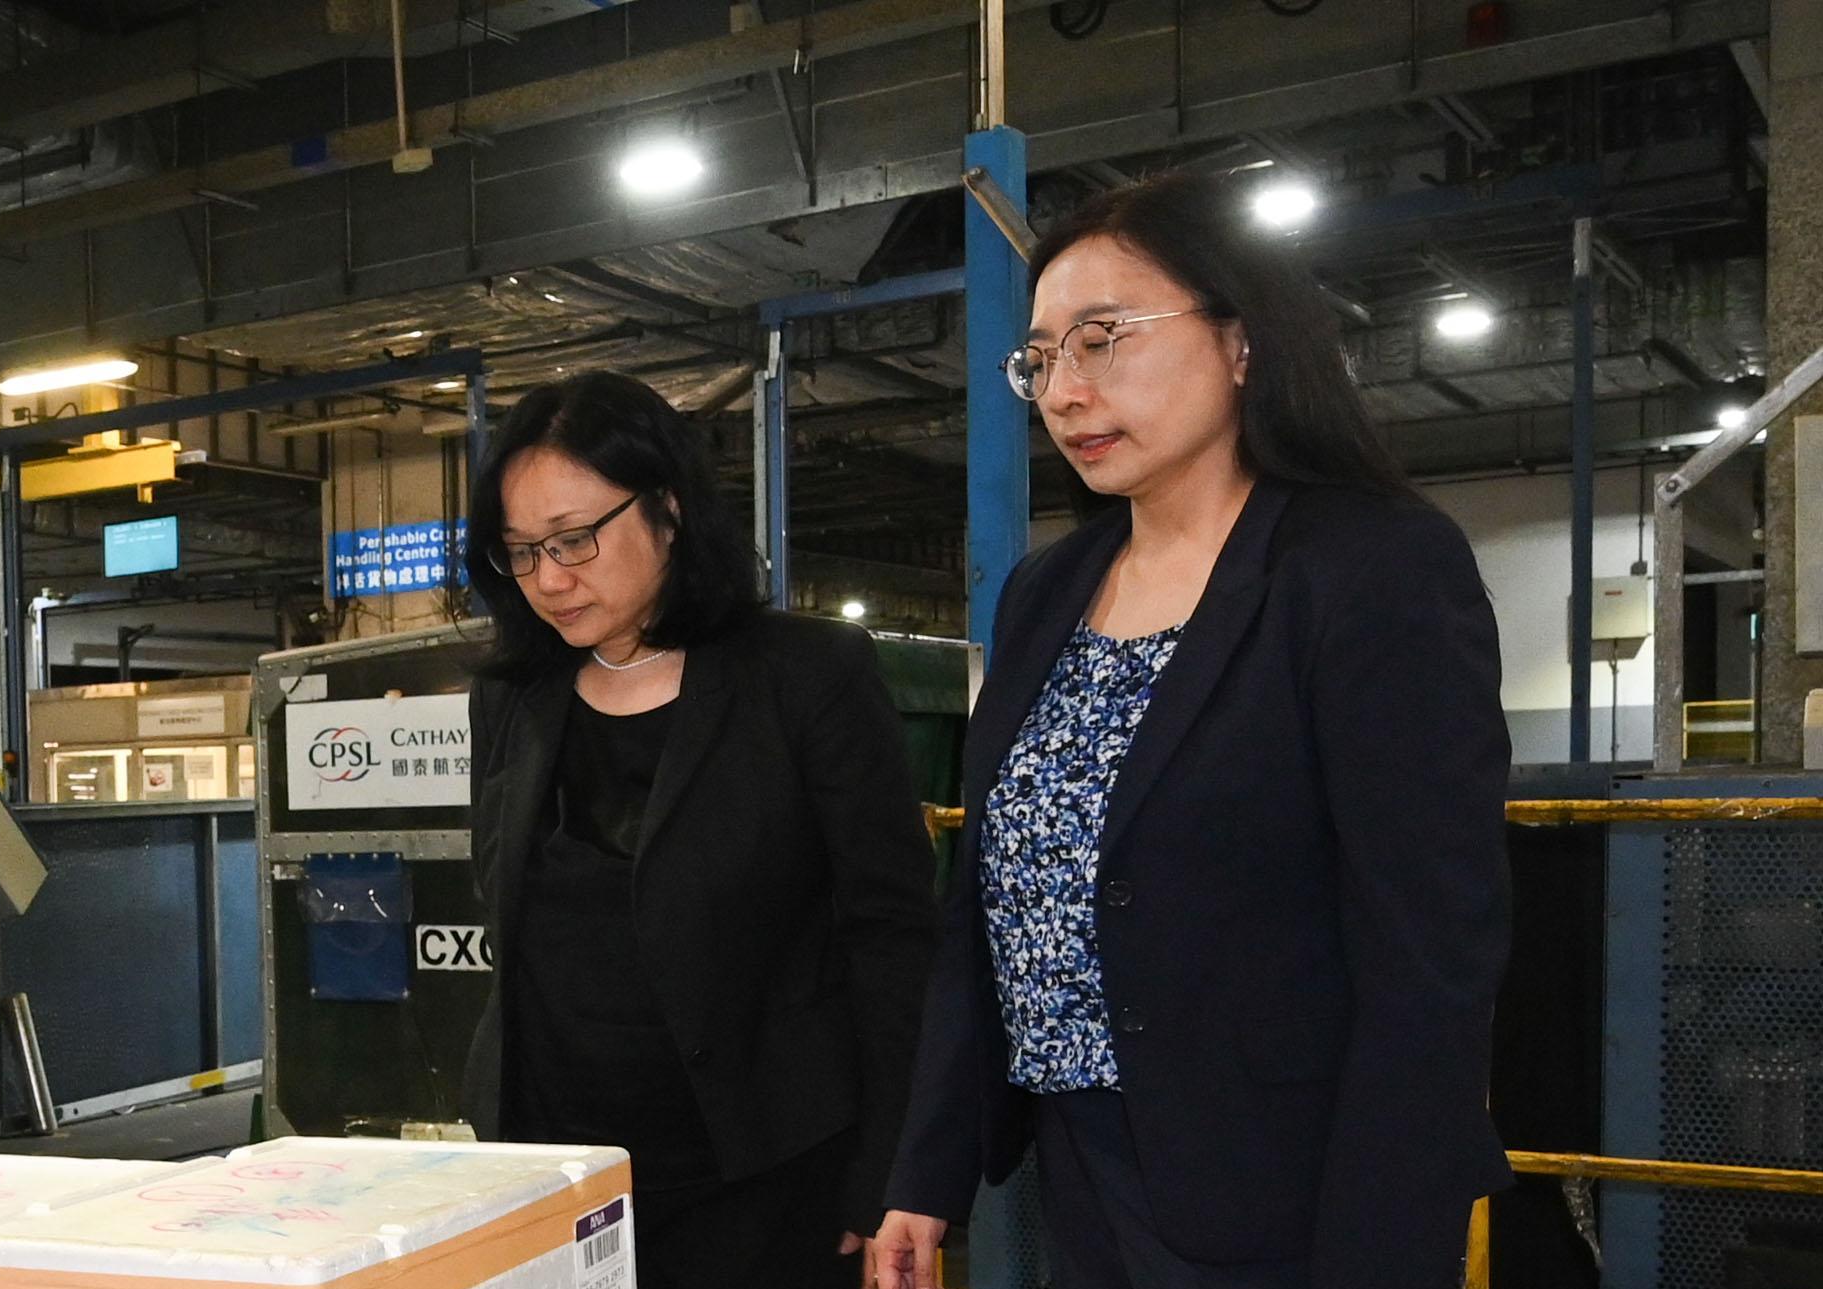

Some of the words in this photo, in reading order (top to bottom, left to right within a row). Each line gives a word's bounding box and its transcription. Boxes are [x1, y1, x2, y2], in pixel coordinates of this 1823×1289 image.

[359, 530, 428, 550] Pershable
[336, 551, 393, 568] Handlig
[395, 546, 439, 561] Centre
[390, 727, 470, 748] CATHAY
[308, 740, 382, 769] CPSL
[391, 756, 471, 778] 國泰航空
